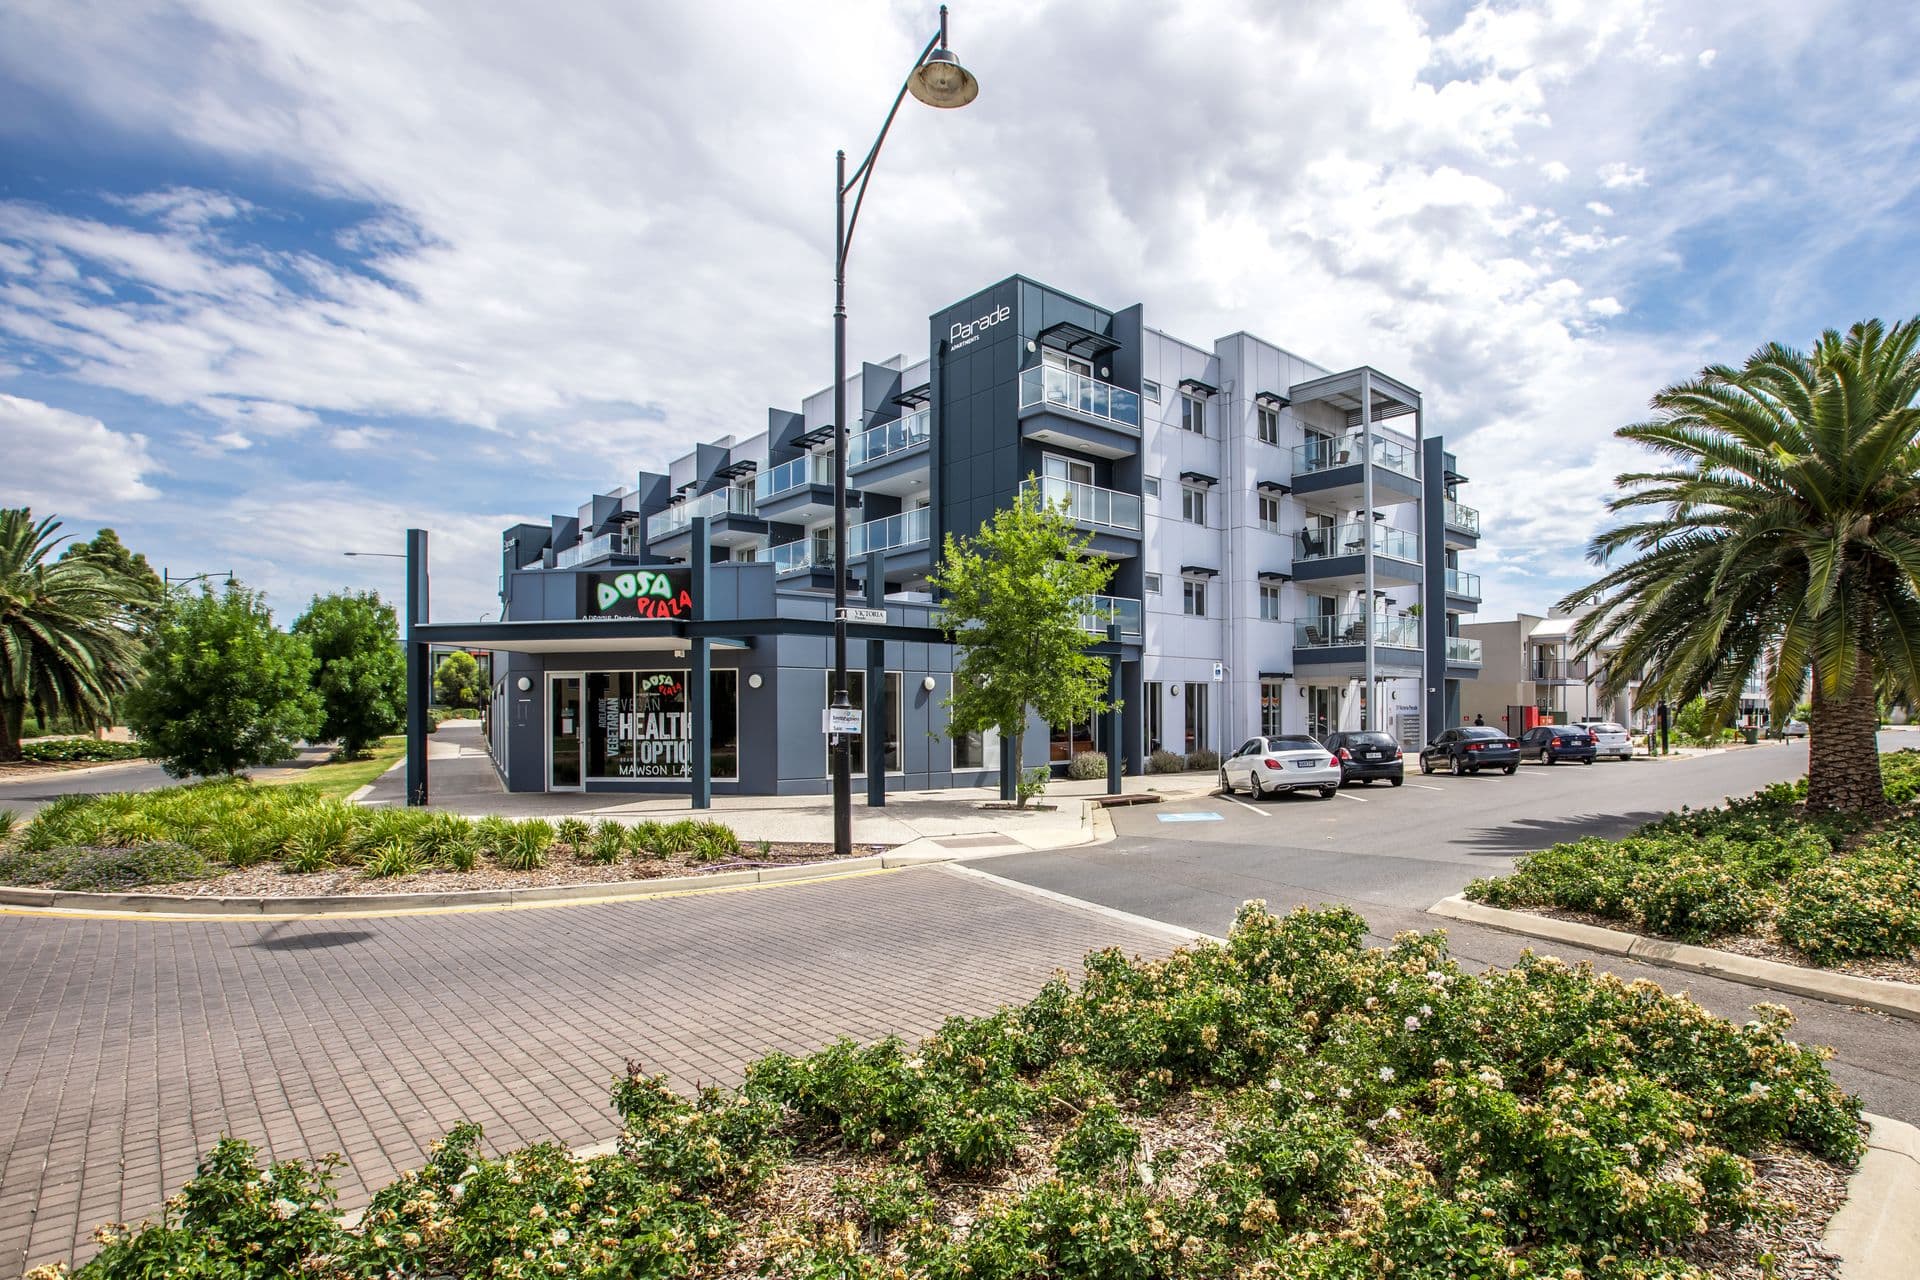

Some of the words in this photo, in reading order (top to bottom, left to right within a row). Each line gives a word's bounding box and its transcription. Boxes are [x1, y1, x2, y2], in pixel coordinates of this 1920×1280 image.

[951, 304, 1010, 344] Parade
[597, 571, 673, 611] DOSA
[637, 590, 693, 619] PLAZA
[642, 674, 674, 691] DOSA
[658, 682, 682, 696] PLAZA
[607, 697, 619, 757] VEGETARIAN
[619, 712, 692, 740] HEALTH
[640, 741, 692, 764] OPTIO
[619, 765, 668, 776] MAWSON
[672, 765, 692, 776] LAK
